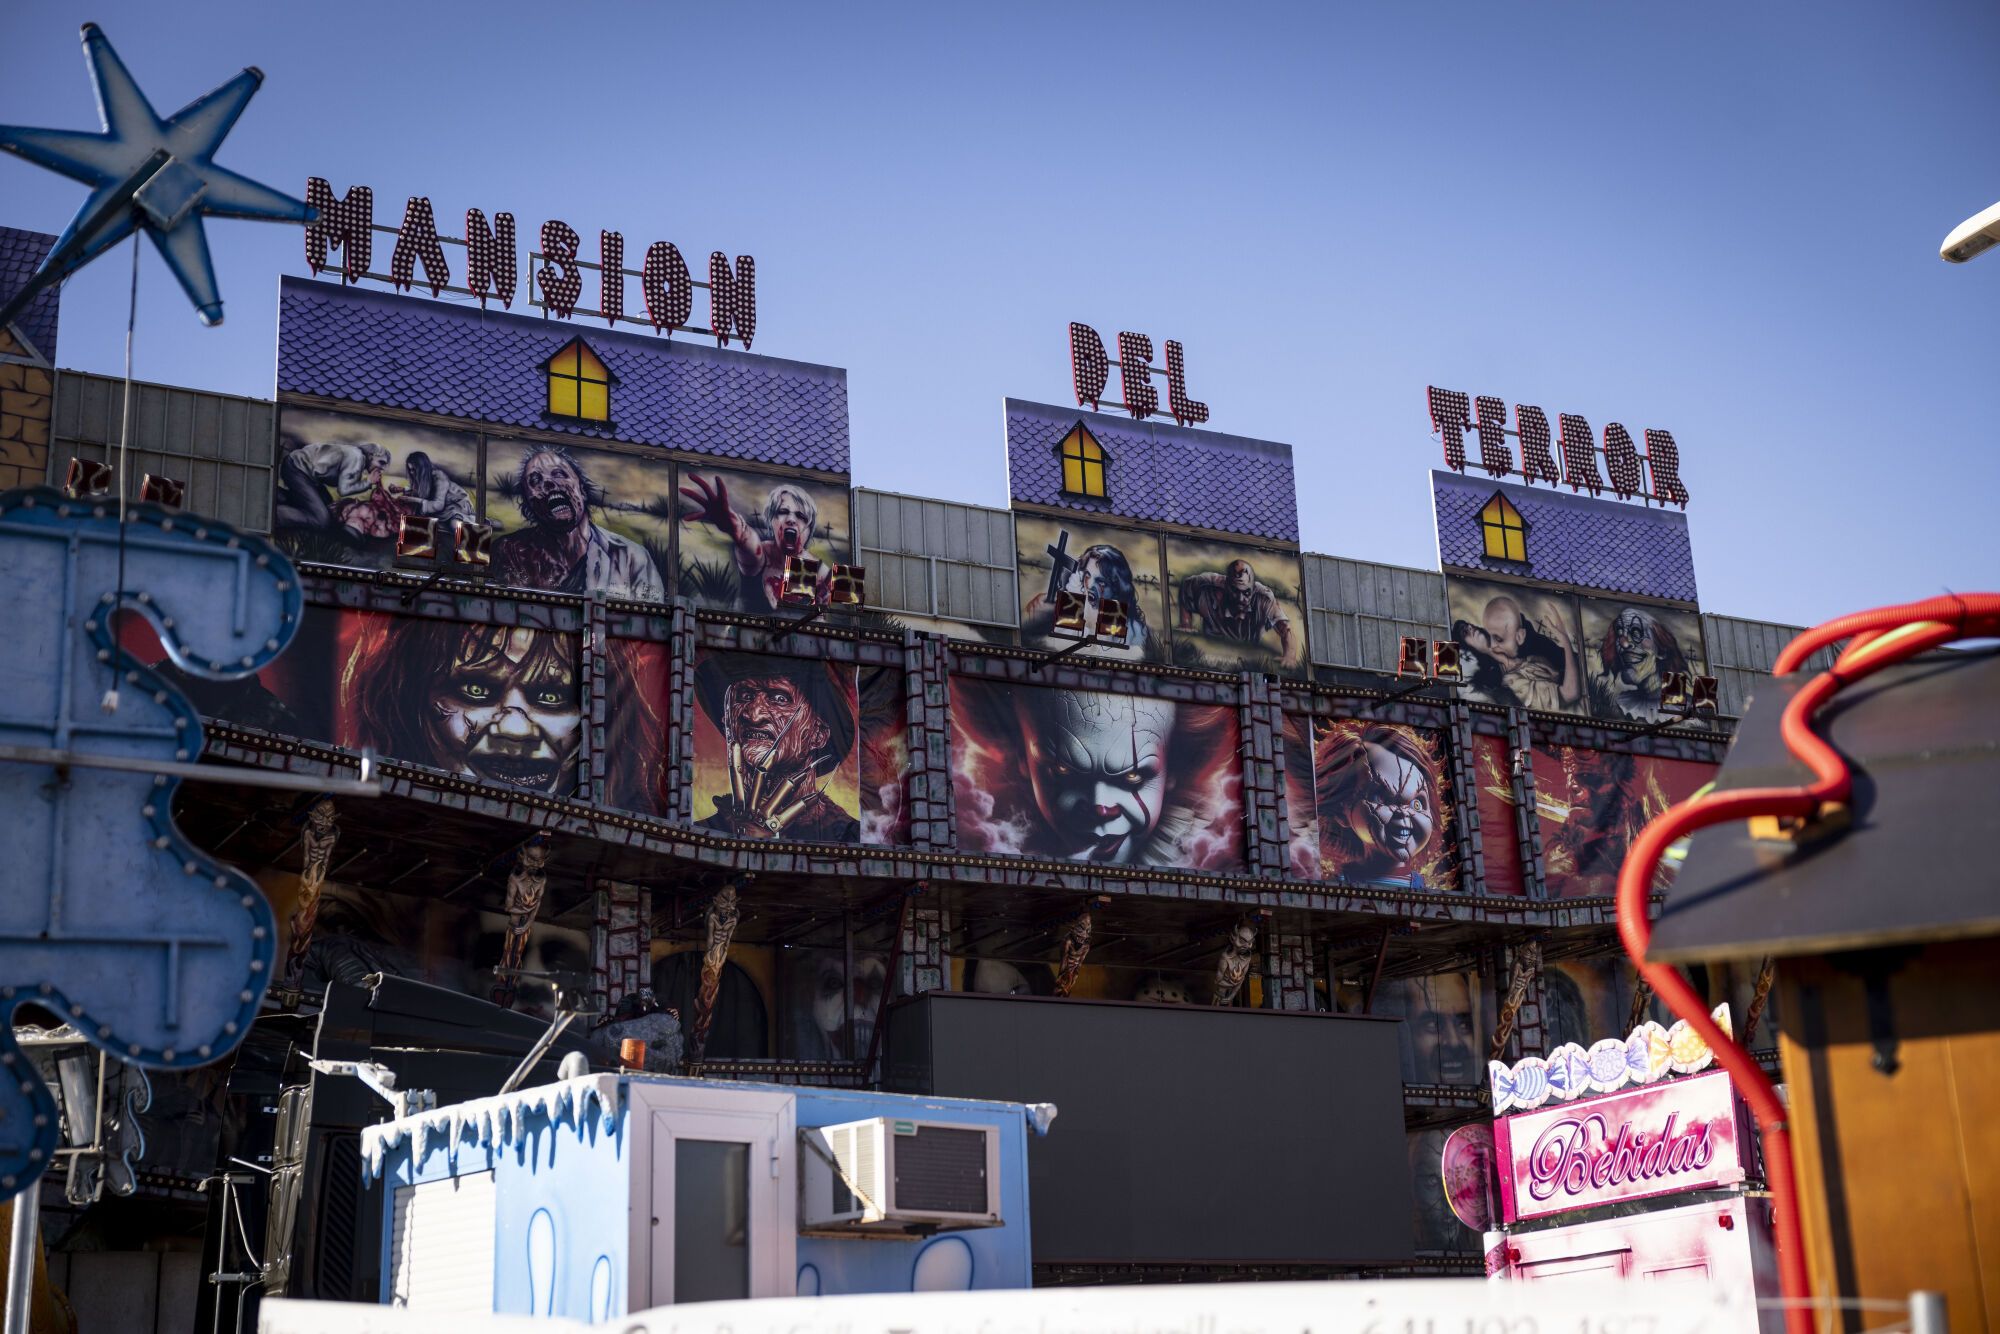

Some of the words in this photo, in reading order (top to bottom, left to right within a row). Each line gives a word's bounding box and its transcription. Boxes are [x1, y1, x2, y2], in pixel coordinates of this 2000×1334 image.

[306, 177, 756, 351] MANSION
[1069, 322, 1209, 427] DEL
[1427, 385, 1689, 511] TERROR
[1529, 1111, 1715, 1201] Bebidas
